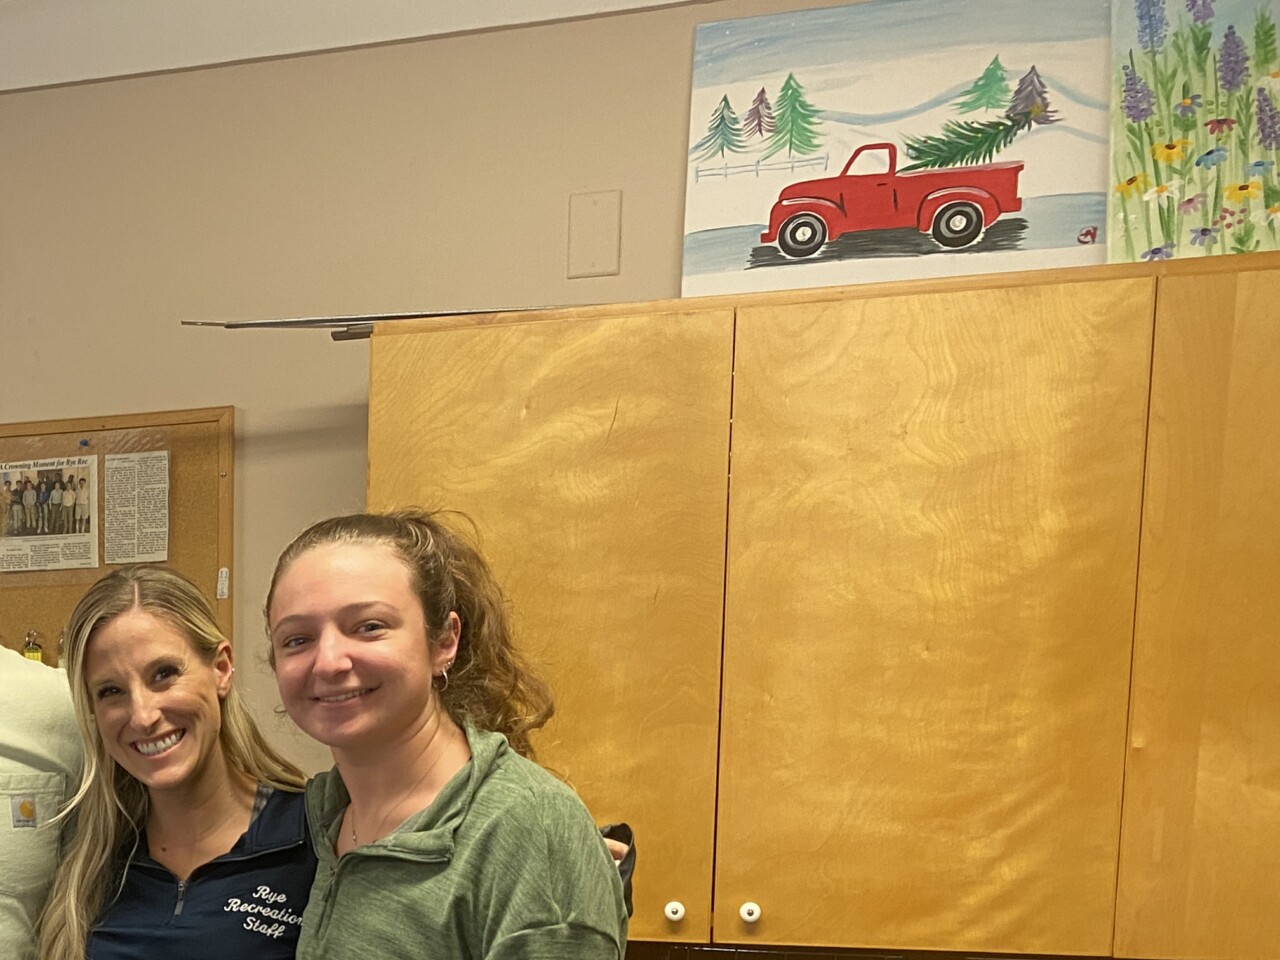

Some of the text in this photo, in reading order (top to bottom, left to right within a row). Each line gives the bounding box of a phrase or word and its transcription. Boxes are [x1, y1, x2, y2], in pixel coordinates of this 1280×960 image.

[55, 459, 64, 468] for
[66, 459, 76, 467] Rye
[252, 885, 287, 904] Rye
[243, 916, 286, 939] Staff
